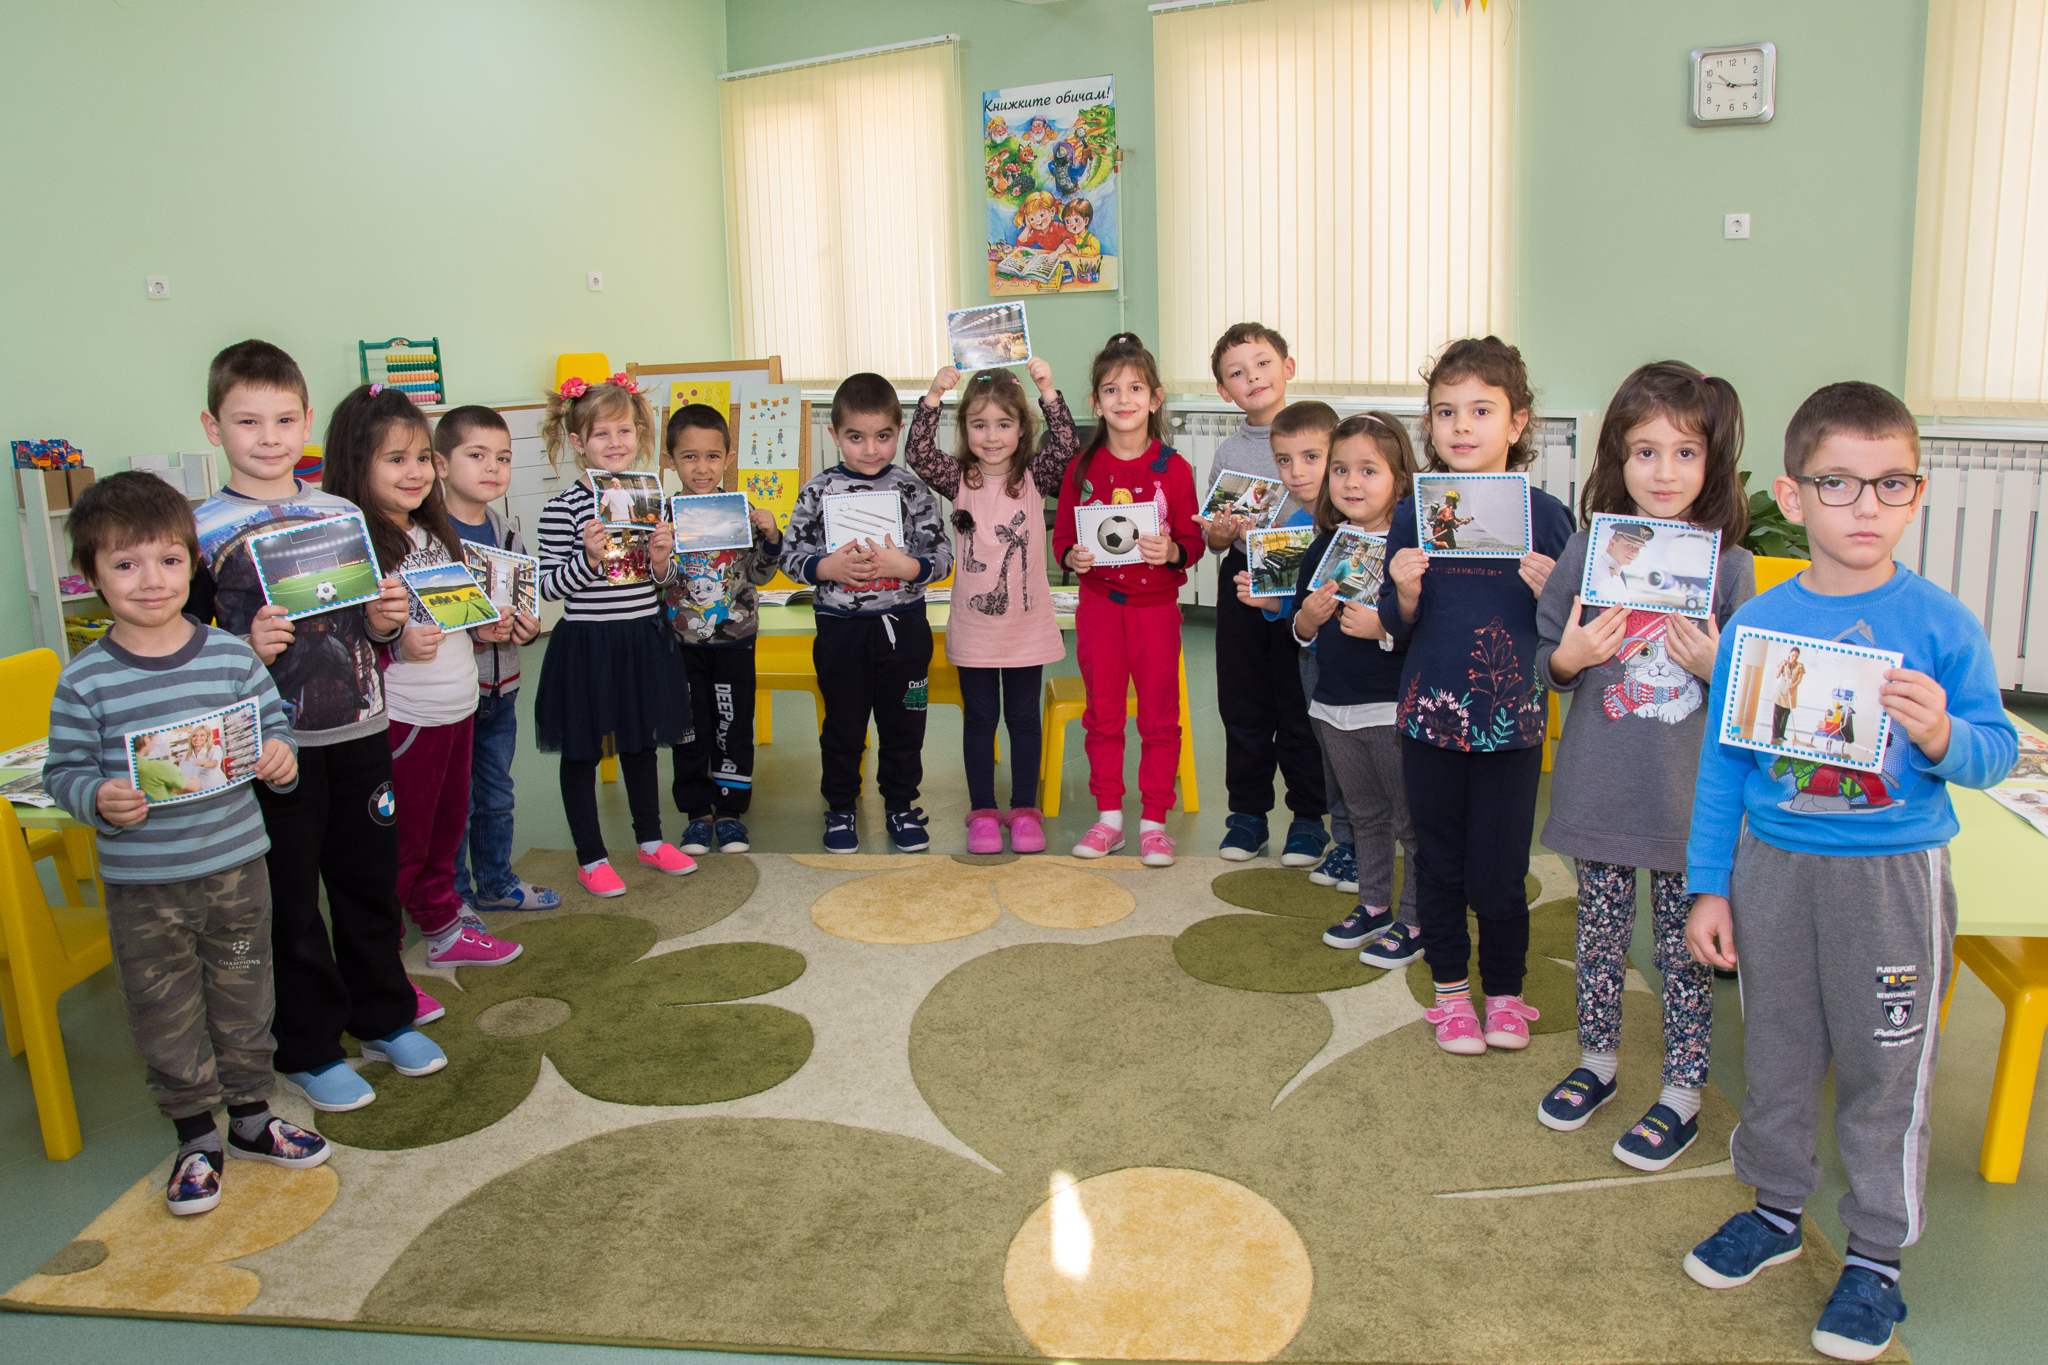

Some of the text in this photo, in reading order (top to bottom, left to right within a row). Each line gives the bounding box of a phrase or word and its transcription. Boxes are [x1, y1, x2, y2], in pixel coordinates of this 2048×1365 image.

[1716, 60, 1723, 68] 11
[1729, 59, 1737, 67] 12
[1706, 69, 1713, 77] 10
[1752, 65, 1758, 74] 2
[1706, 83, 1712, 91] 9
[1752, 78, 1758, 87] 3
[984, 86, 1111, 113] Книжките обичам!
[1706, 96, 1712, 105] 8
[1752, 92, 1758, 100] 4
[1715, 104, 1721, 112] 7
[1729, 103, 1735, 112] 6
[1742, 102, 1748, 110] 5
[679, 554, 710, 569] PAW
[714, 683, 734, 722] DEEP
[1645, 1115, 1670, 1132] FASHION
